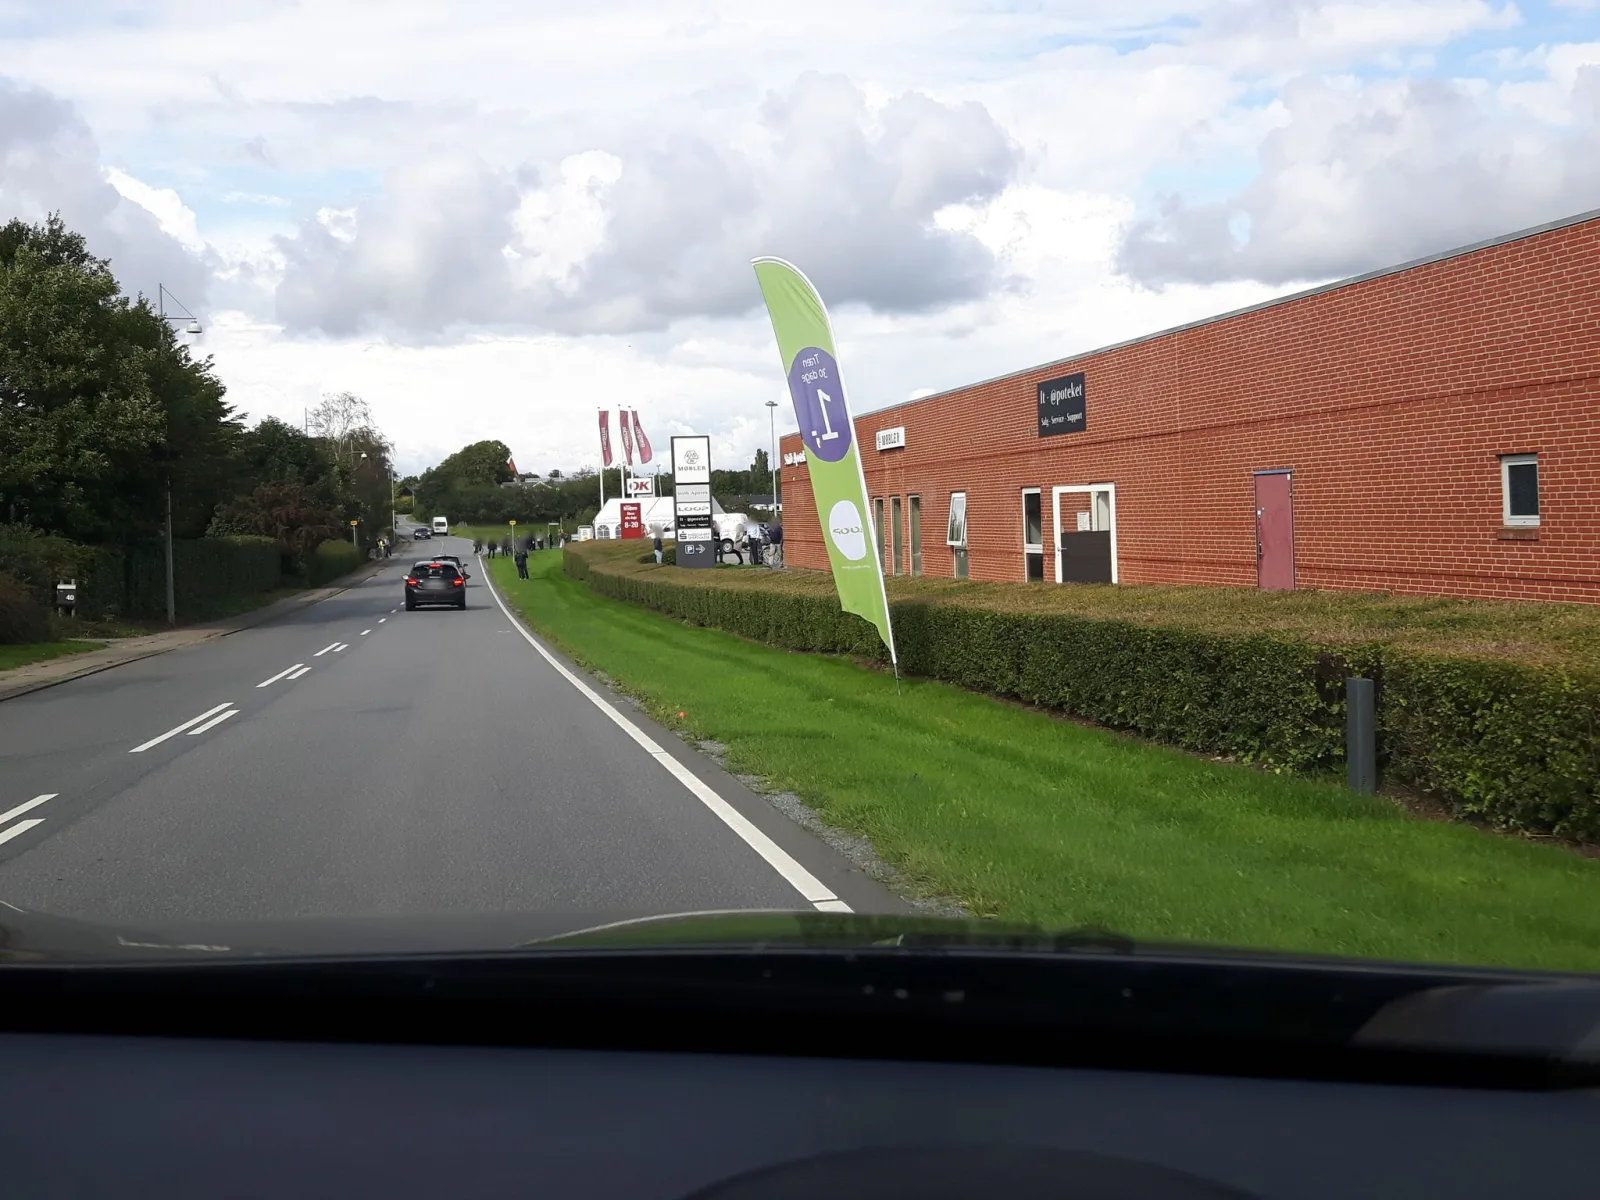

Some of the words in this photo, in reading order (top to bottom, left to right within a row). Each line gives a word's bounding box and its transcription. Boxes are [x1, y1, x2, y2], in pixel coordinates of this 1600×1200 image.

[1066, 412, 1083, 423] Support
[629, 481, 650, 491] OK
[624, 521, 639, 529] 8-20
